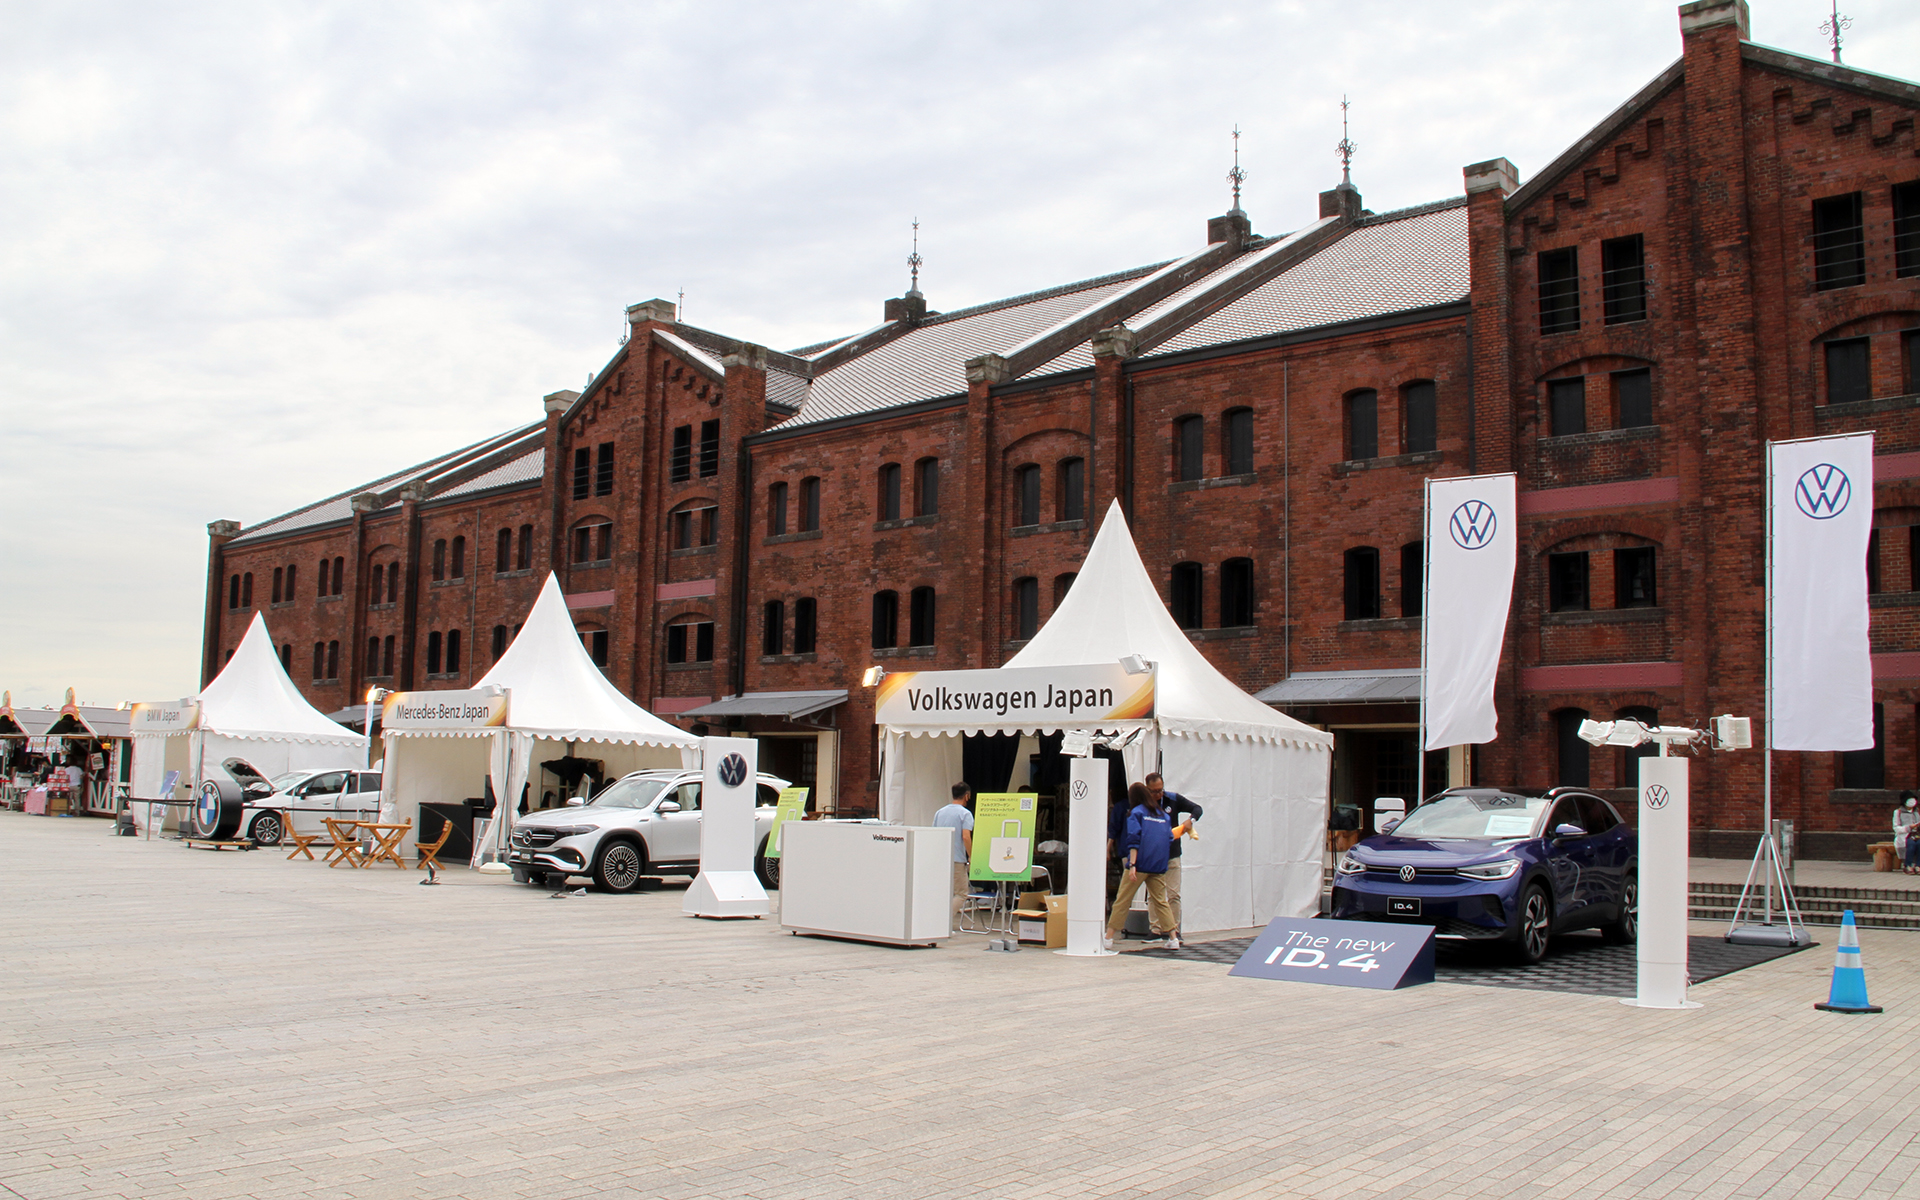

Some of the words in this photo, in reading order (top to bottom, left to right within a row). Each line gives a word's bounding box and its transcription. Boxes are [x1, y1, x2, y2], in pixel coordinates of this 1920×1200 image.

[908, 686, 1037, 716] Volkswagen
[1043, 684, 1113, 714] Japan
[147, 709, 162, 721] BMW
[162, 708, 180, 724] Japan
[396, 703, 461, 719] Mercedes-Benz
[461, 703, 489, 722] Japan
[872, 833, 905, 844] Volkswagen
[1394, 903, 1414, 911] ID.4
[1285, 930, 1330, 948] The
[1335, 937, 1396, 953] new
